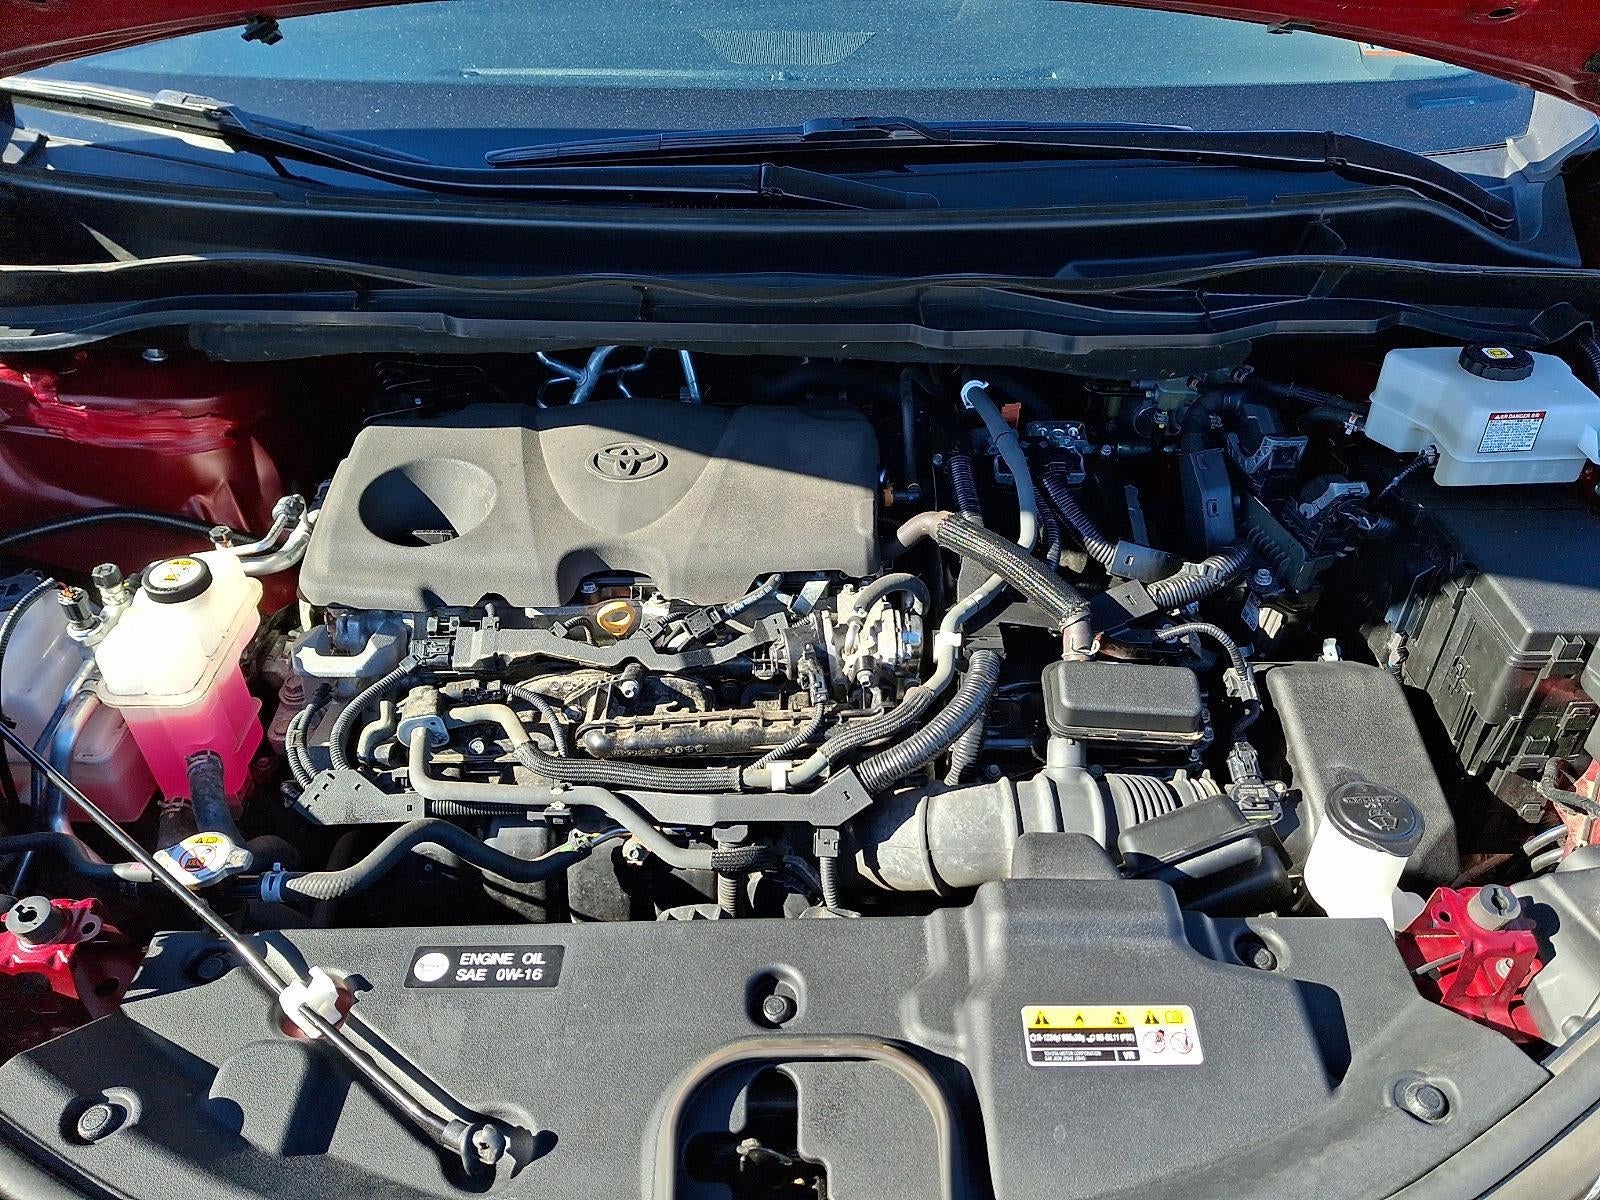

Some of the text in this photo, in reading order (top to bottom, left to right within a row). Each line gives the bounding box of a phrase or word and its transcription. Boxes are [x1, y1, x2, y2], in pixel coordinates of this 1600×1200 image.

[459, 952, 546, 966] ENGINE OIL
[455, 967, 544, 982] SAE 0W-16
